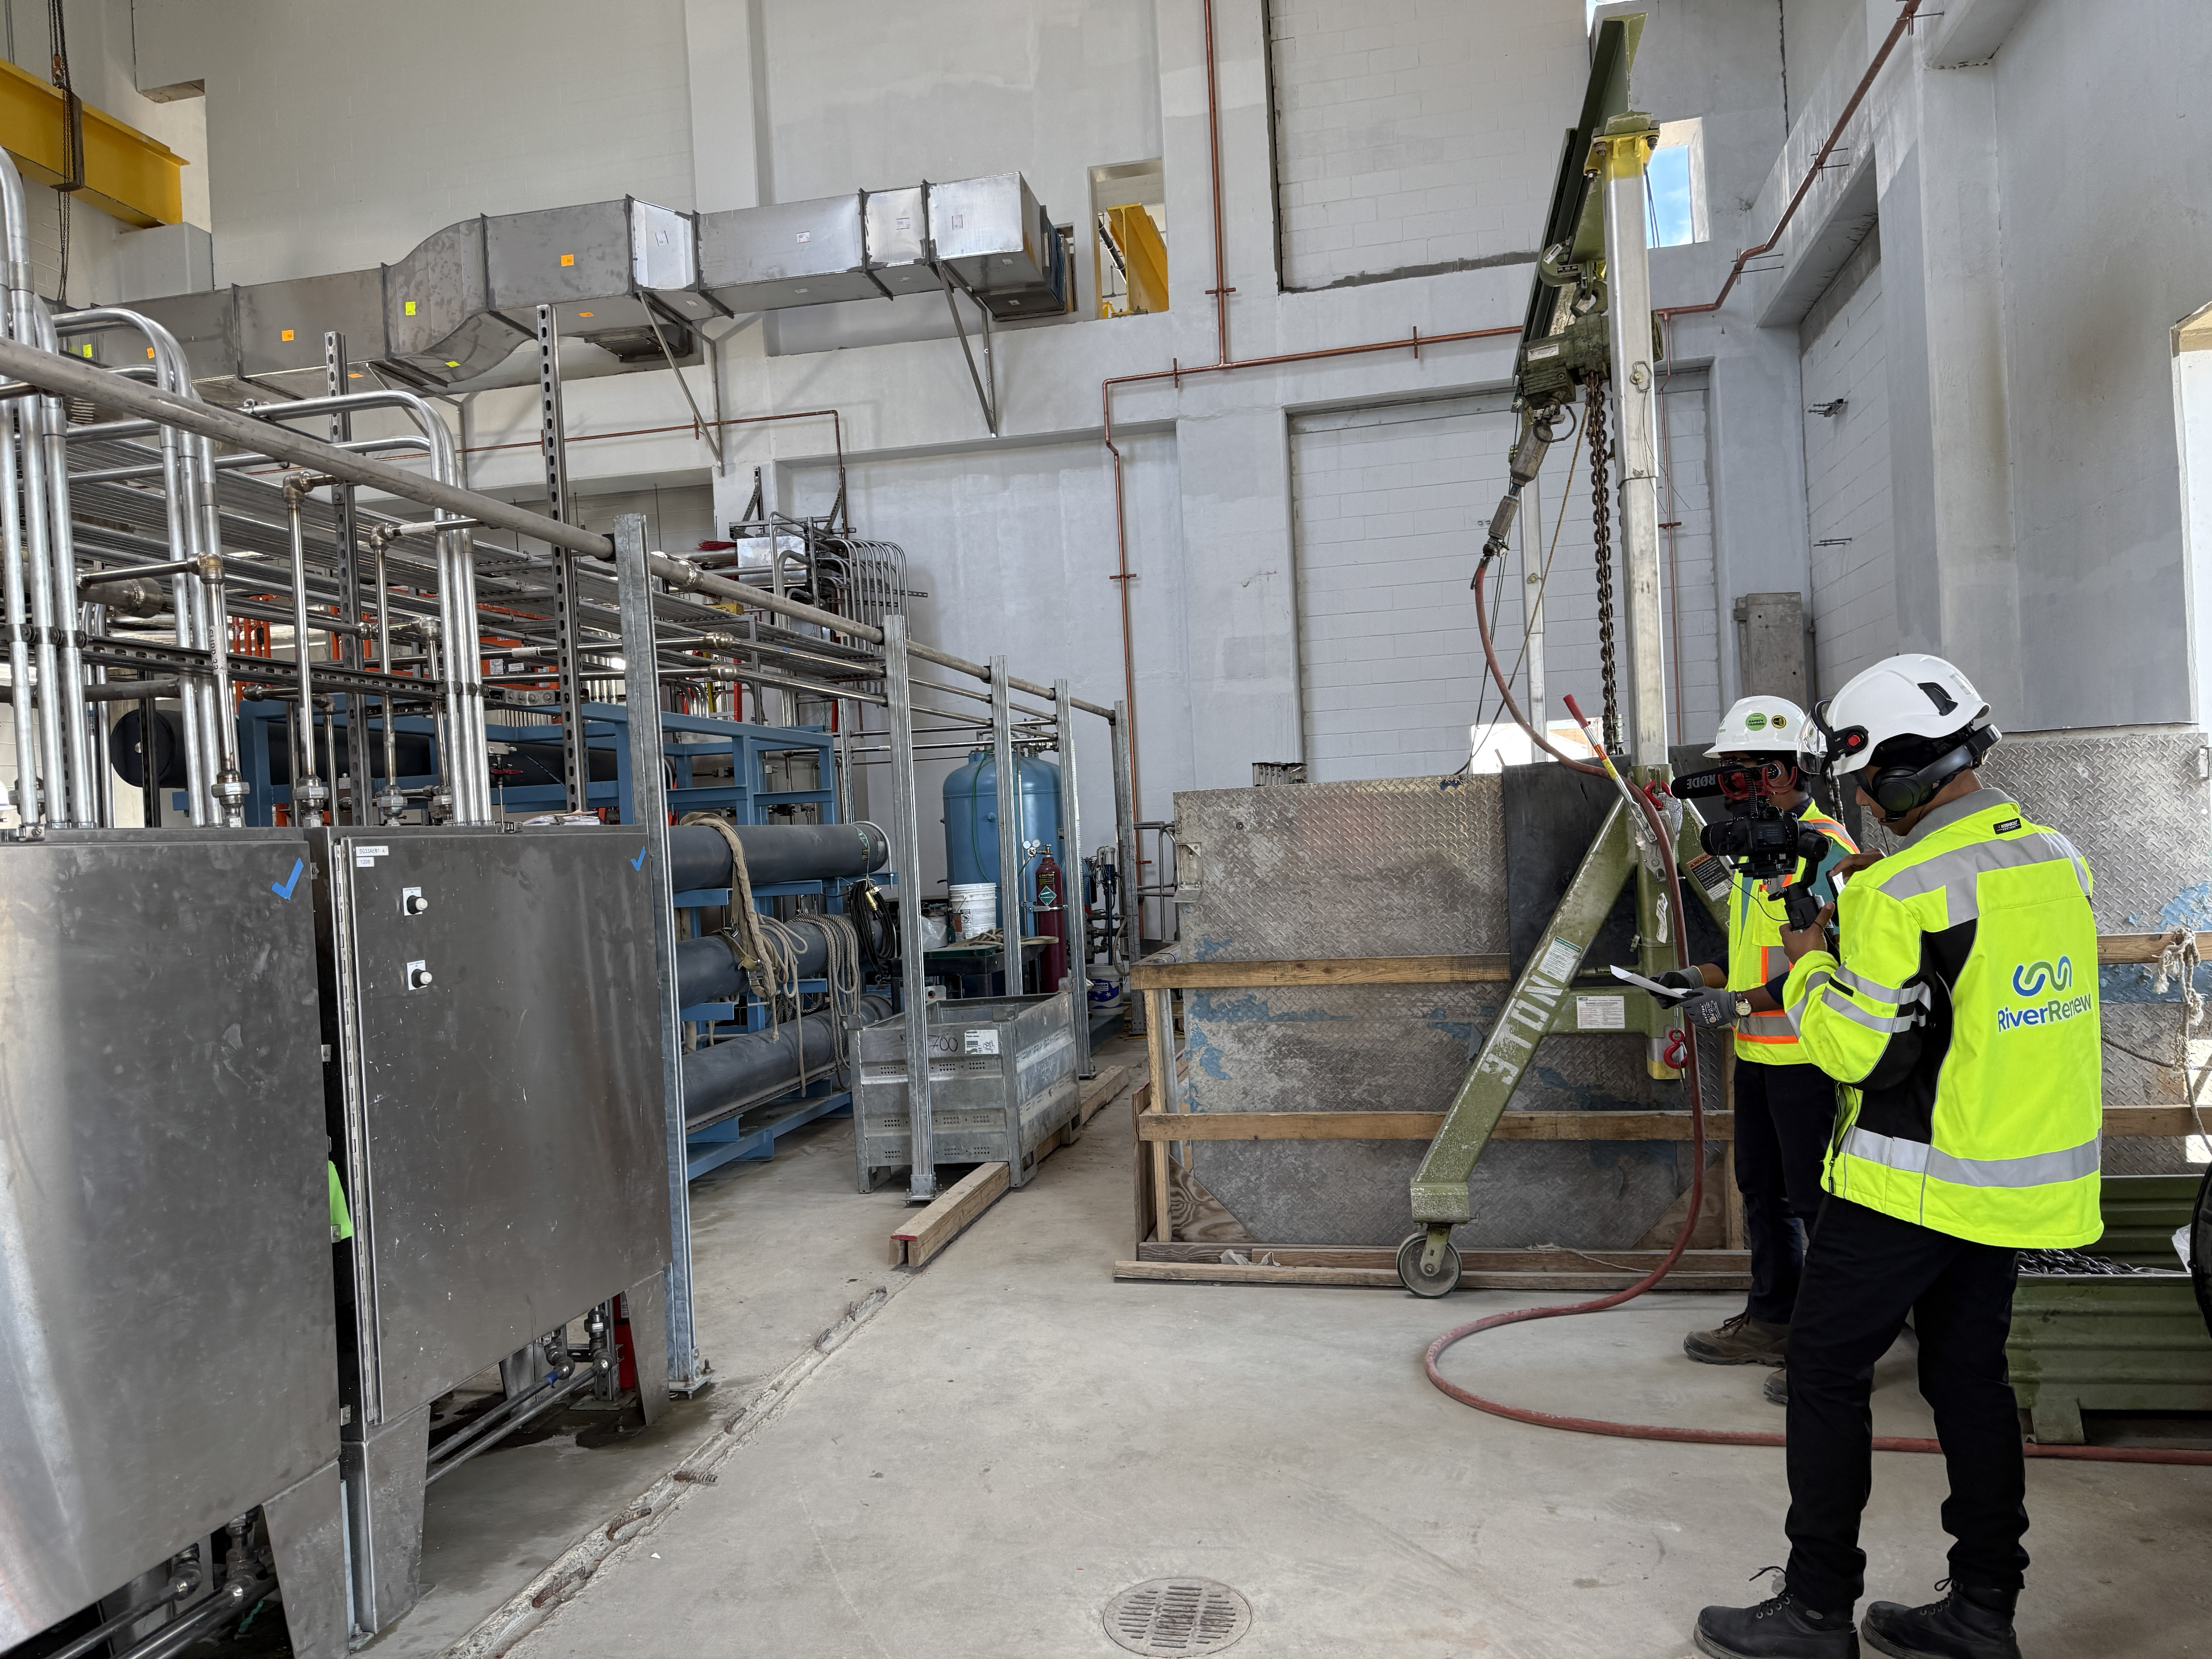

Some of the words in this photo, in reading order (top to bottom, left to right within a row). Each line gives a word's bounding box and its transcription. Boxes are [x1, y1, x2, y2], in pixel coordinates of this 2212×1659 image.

[1686, 774, 1716, 790] RØDE
[1497, 974, 1563, 1050] TON
[1997, 993, 2092, 1032] RiverRenew
[928, 1033, 958, 1052] 700
[1481, 1053, 1519, 1085] 3
